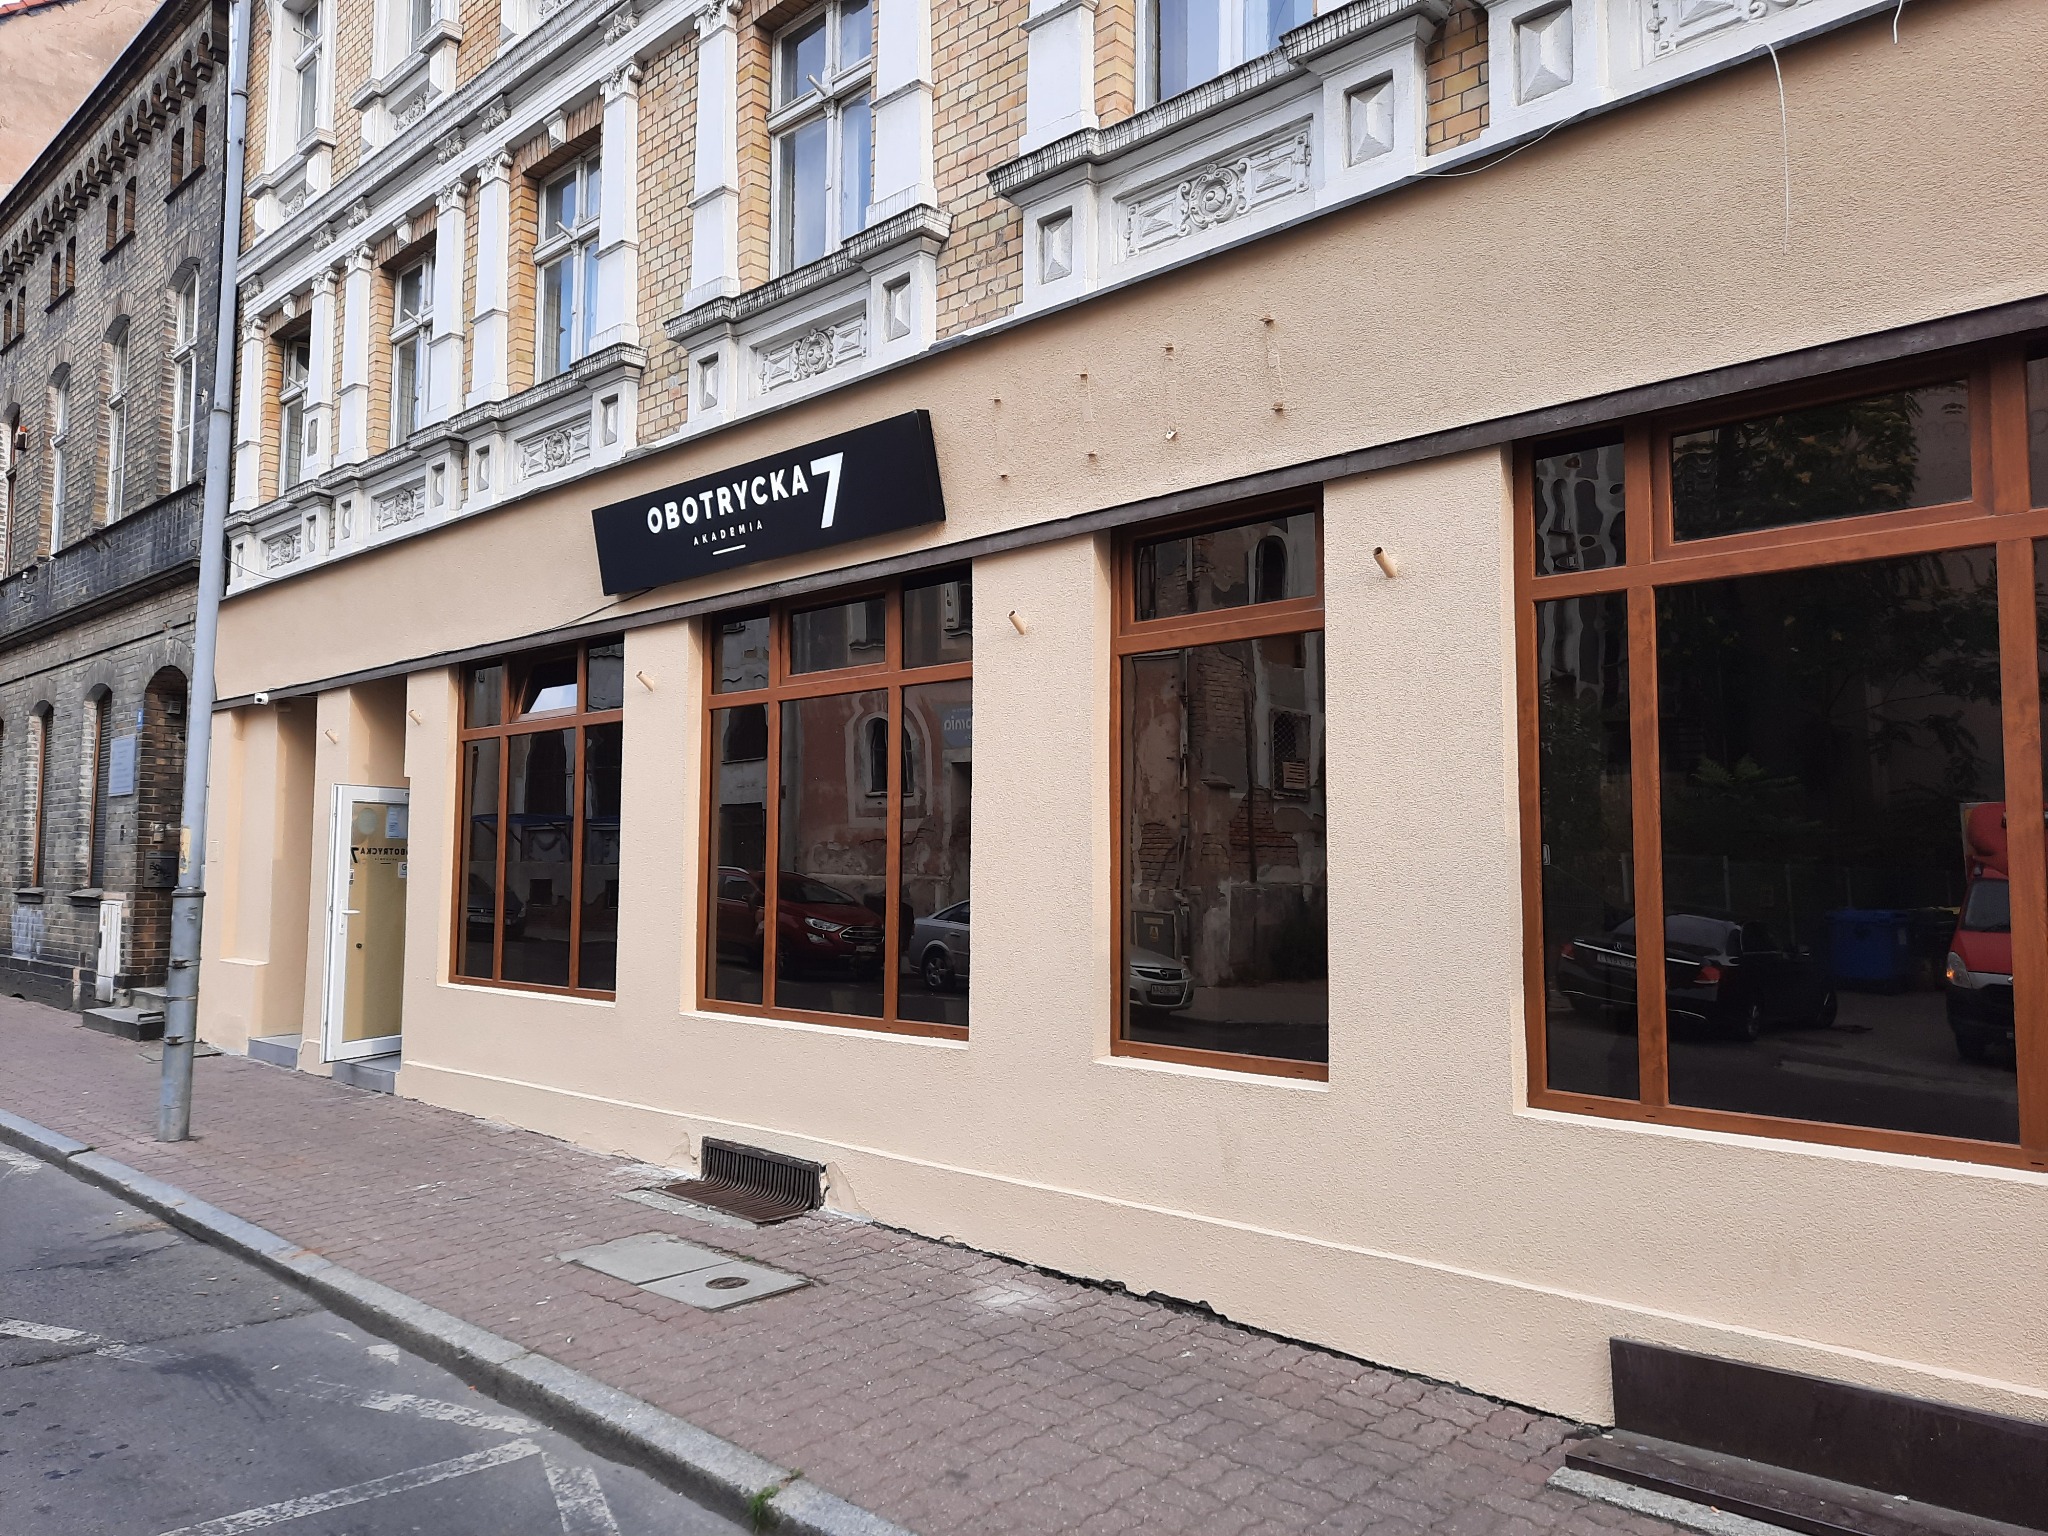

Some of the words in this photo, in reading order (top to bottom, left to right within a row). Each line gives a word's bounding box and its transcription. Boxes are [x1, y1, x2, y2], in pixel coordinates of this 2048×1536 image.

[647, 464, 809, 533] OBOTRYCKA
[811, 452, 844, 529] 7
[692, 519, 764, 546] AKADEMIA
